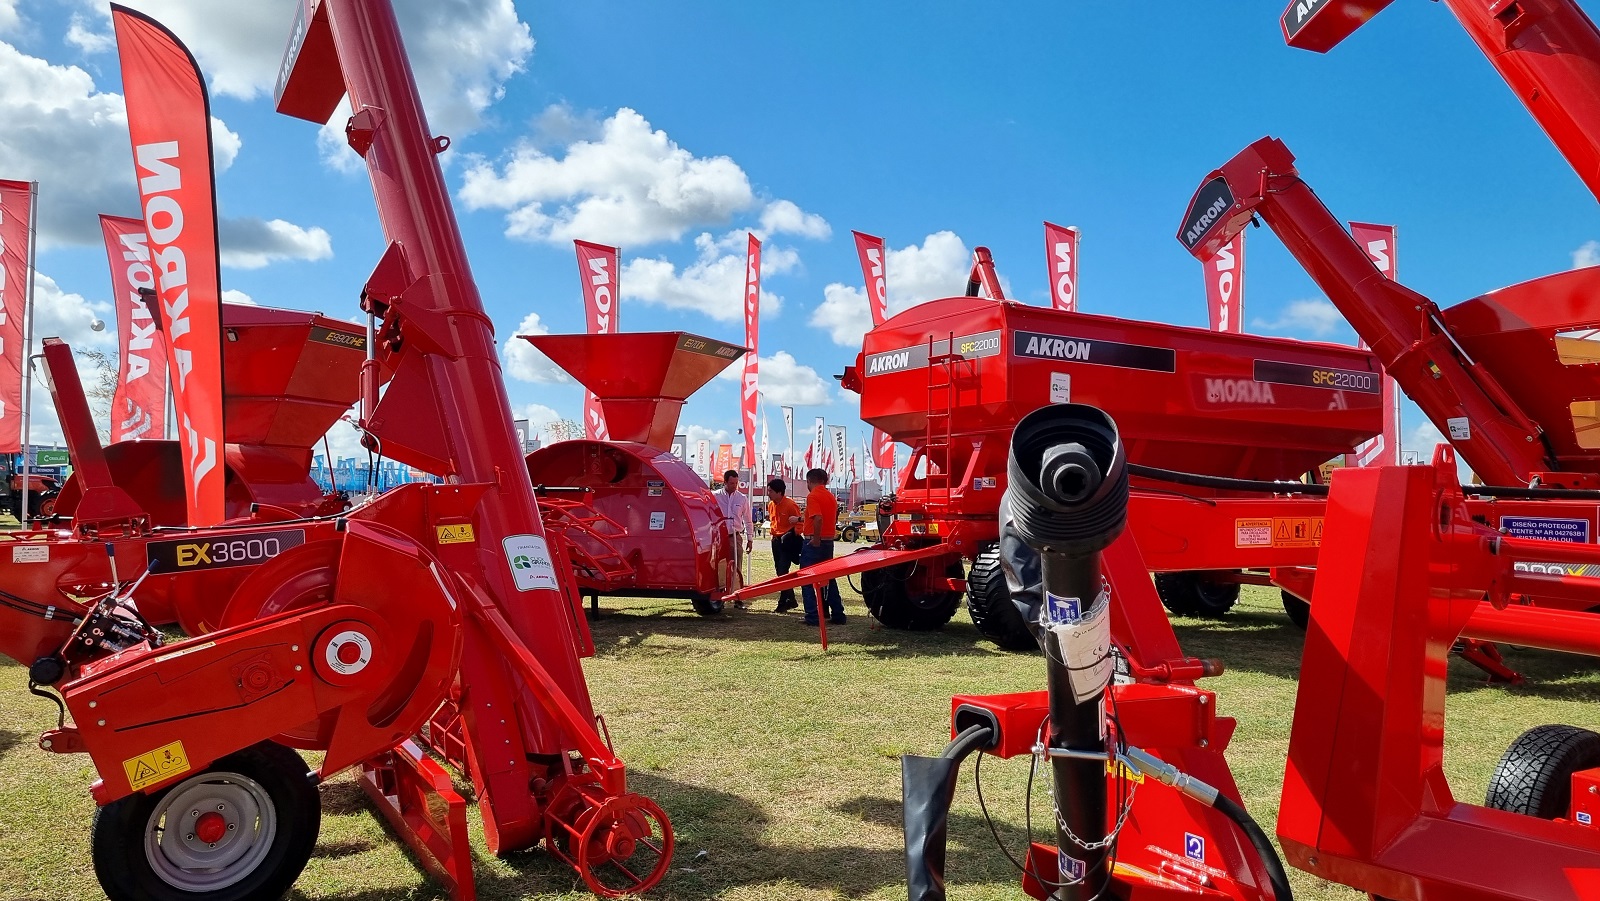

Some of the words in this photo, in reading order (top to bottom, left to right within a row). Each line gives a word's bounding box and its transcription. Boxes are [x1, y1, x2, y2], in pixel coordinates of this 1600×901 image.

[281, 19, 303, 89] AKRON
[1186, 196, 1227, 244] AKRON
[715, 346, 738, 357] AKRON
[961, 338, 999, 354] SFC22000
[1025, 336, 1091, 360] AKRON
[870, 352, 909, 374] AKRON
[1312, 370, 1371, 390] SFC22000
[1538, 522, 1578, 530] PROTEGIDO
[177, 538, 280, 567] EX3600
